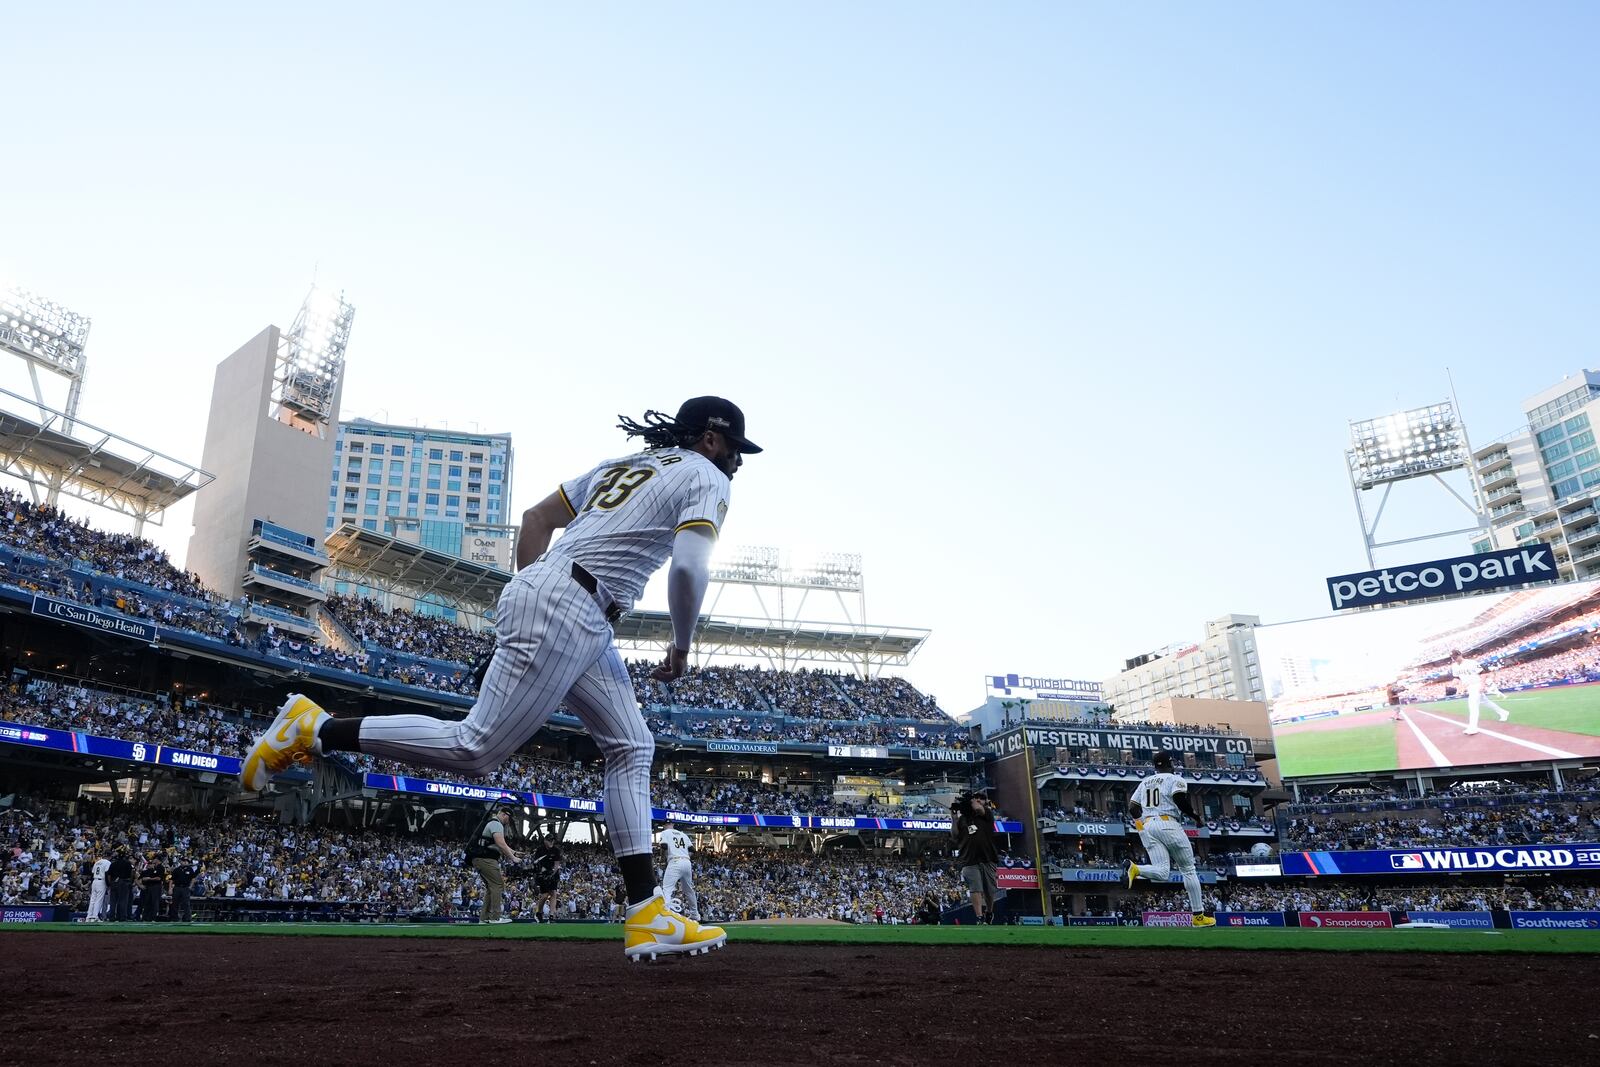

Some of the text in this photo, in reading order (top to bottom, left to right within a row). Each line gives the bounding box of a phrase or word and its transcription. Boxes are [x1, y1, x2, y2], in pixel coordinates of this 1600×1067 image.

[656, 453, 682, 467] JR
[582, 464, 656, 512] 23
[471, 552, 497, 562] HOTEL
[1331, 549, 1552, 607] petco park
[48, 602, 146, 636] UC San Diego Health
[1022, 676, 1101, 693] QuidelOrtho
[1025, 729, 1252, 754] WESTERN METAL SUPPLY CO.
[709, 743, 776, 753] CIUDAD MADERAS
[172, 752, 191, 765] SAN
[191, 755, 218, 769] DIEGO
[918, 749, 968, 762] CUTWATER
[1145, 787, 1160, 808] 10
[569, 799, 597, 811] ATLANTA
[820, 817, 835, 826] SAN
[834, 818, 855, 827] DIEGO
[1076, 823, 1107, 835] ORIS
[673, 837, 686, 849] 34
[1230, 916, 1270, 925] us bank
[1325, 917, 1386, 929] Snapdragon
[1517, 917, 1589, 928] Southwest
